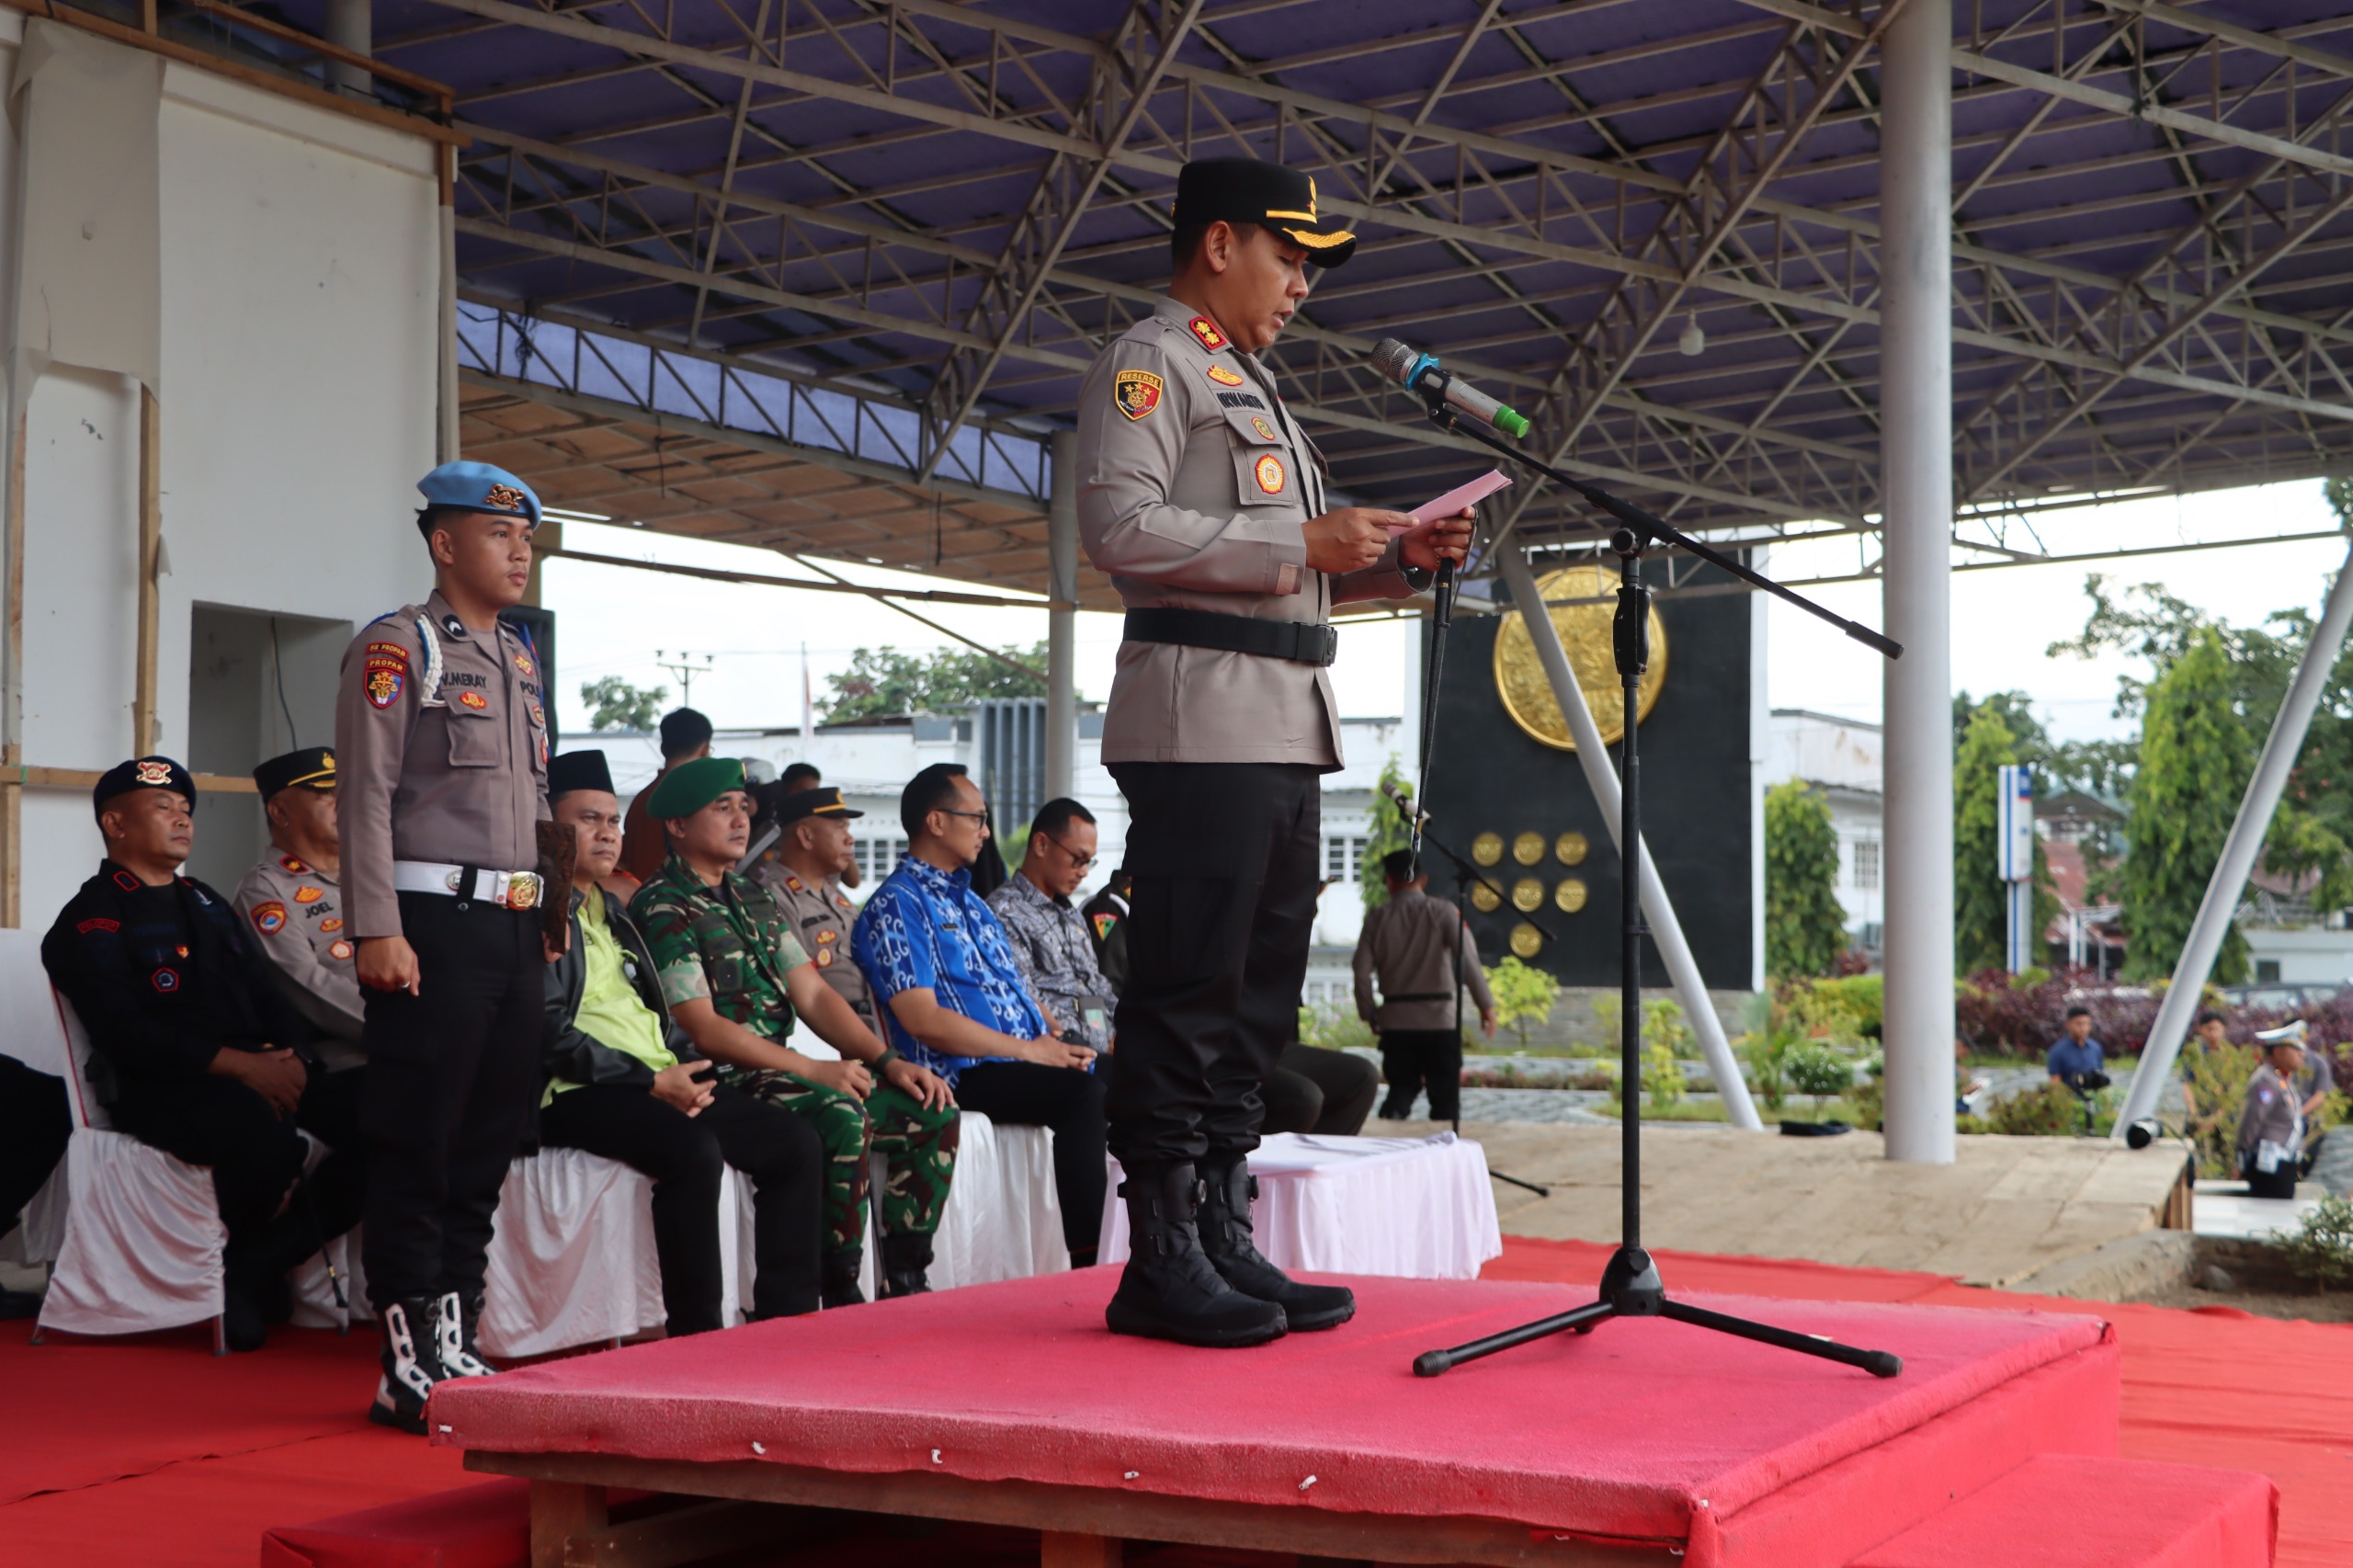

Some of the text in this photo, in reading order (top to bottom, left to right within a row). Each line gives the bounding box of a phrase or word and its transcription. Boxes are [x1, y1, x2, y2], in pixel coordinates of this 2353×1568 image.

[1120, 372, 1159, 387] RESERSE
[1216, 392, 1266, 411] IRWANTO
[381, 643, 406, 657] PROPAM
[369, 659, 404, 671] PROPAM
[305, 902, 335, 918] JOEL
